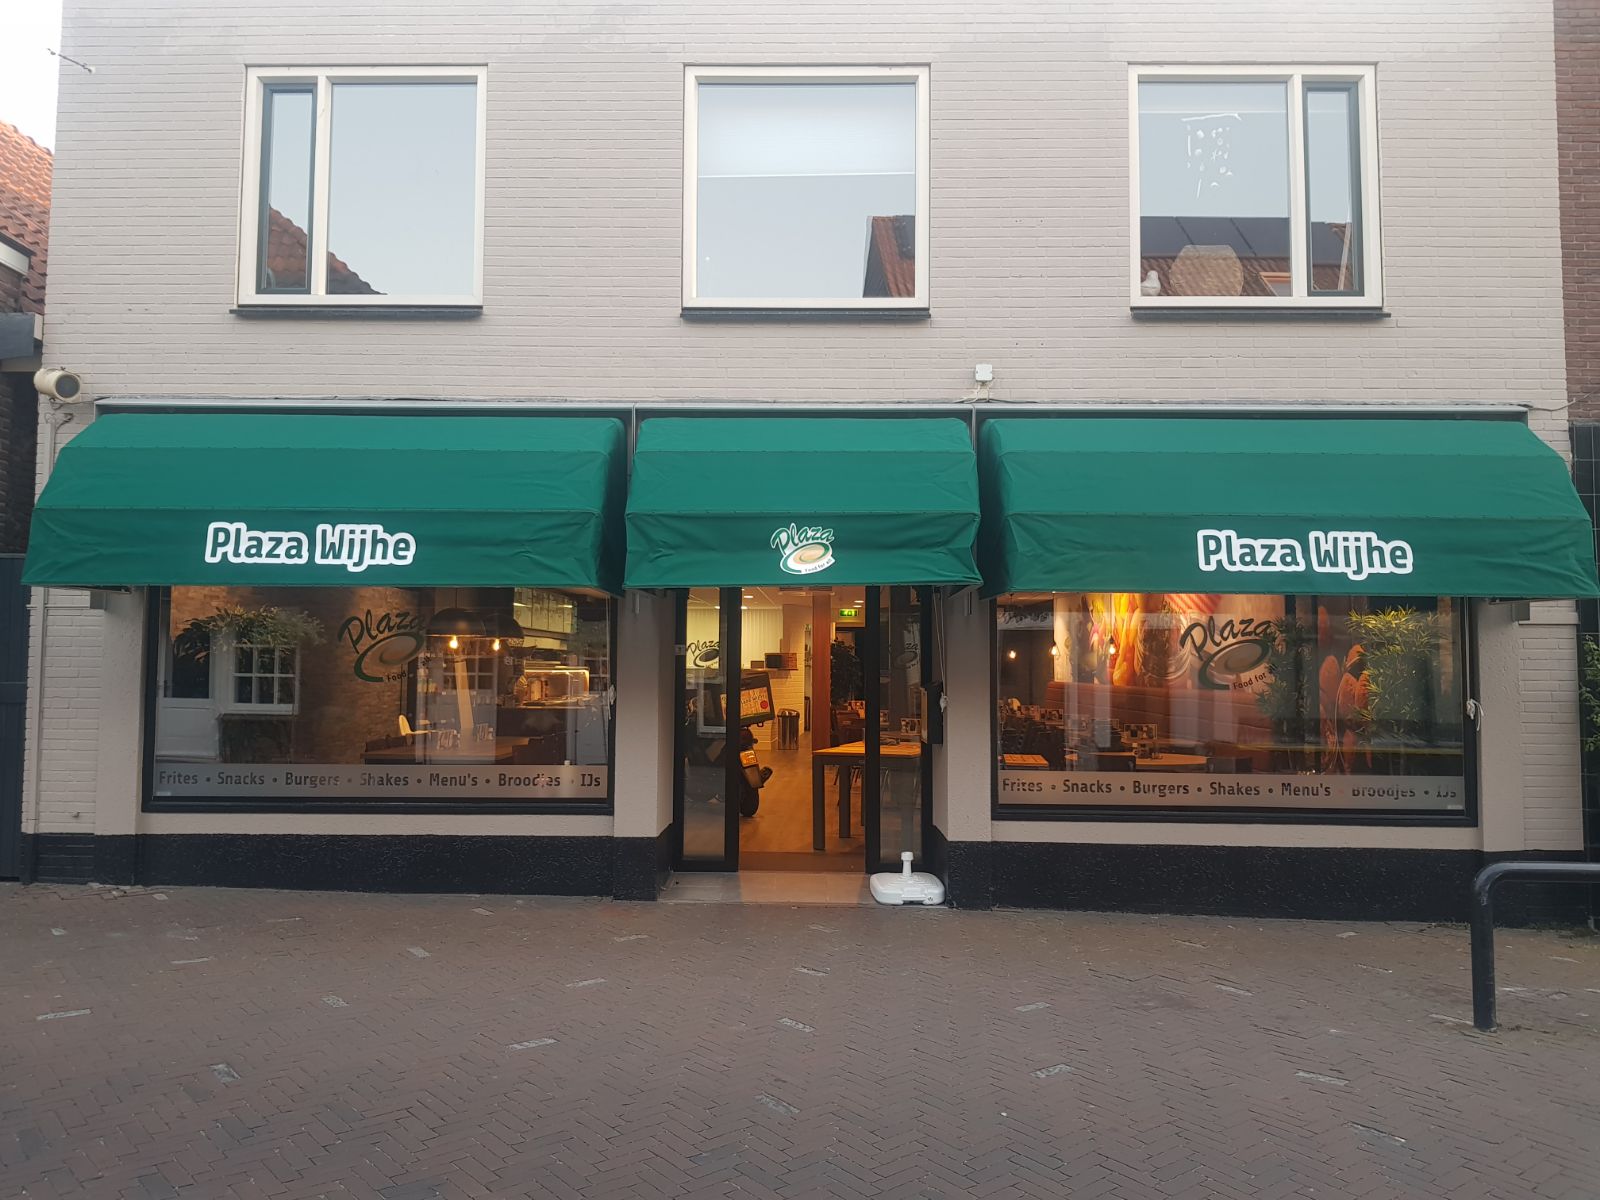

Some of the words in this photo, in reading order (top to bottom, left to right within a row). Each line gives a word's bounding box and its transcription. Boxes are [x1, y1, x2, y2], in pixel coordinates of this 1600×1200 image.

[205, 521, 309, 564] Plaza
[315, 523, 416, 573] Wijhe
[770, 522, 834, 556] Plaza
[1197, 529, 1306, 572] Plaza
[1308, 530, 1413, 581] Wijhe
[1233, 678, 1254, 690] Food
[1254, 671, 1268, 683] for
[159, 771, 198, 785] Frites
[217, 771, 265, 785] Snacks
[285, 772, 340, 789] Burgers
[360, 772, 409, 786] Shakes
[429, 773, 478, 786] Menu's
[1002, 778, 1043, 792] Frites
[1063, 779, 1112, 793] Snacks
[1132, 780, 1190, 797] Burgers
[1209, 782, 1261, 796] Shakes
[1281, 782, 1331, 796] Menu's
